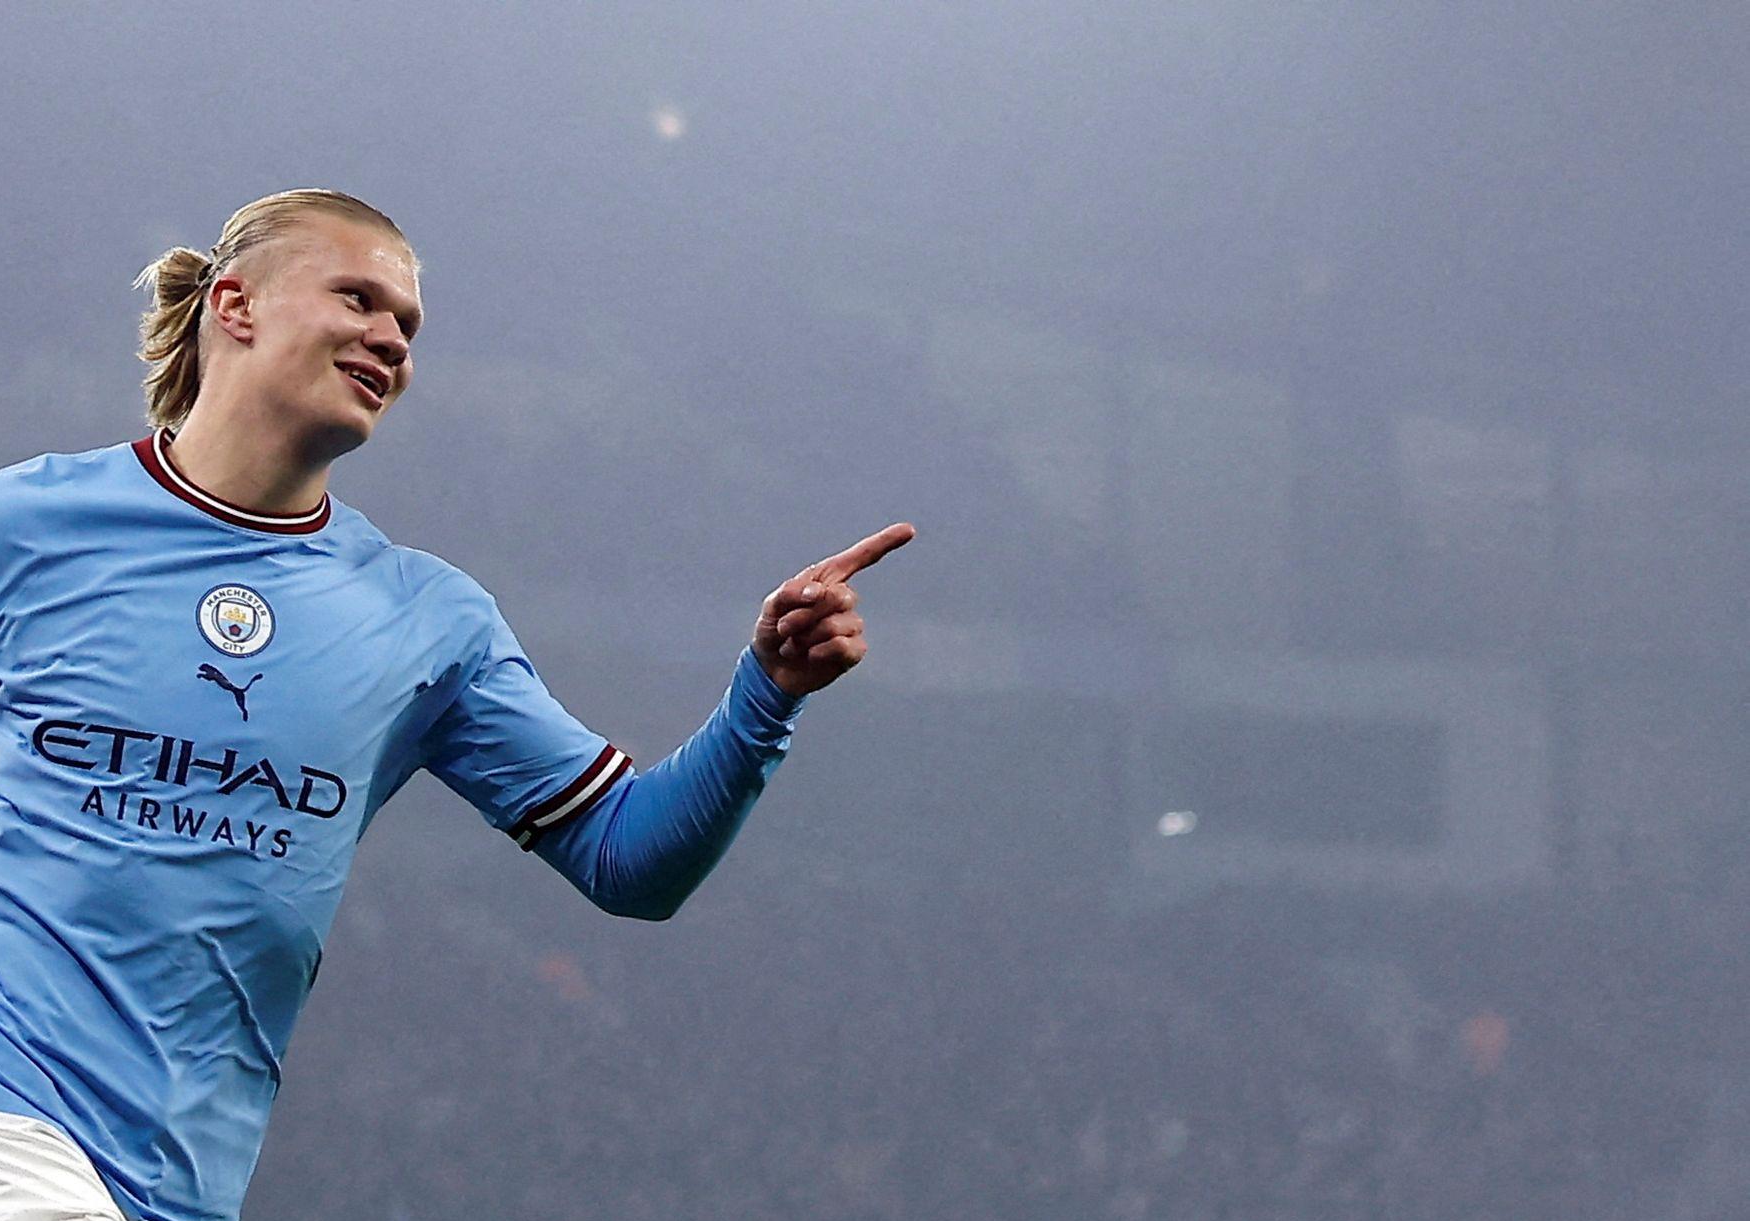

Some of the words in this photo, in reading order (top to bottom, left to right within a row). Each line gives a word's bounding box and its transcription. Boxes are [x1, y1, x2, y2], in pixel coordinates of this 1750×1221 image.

[206, 588, 268, 618] MANCHESTER
[222, 641, 246, 653] CITY
[32, 719, 348, 819] ETIHAD
[79, 785, 292, 859] AIRWAYS
